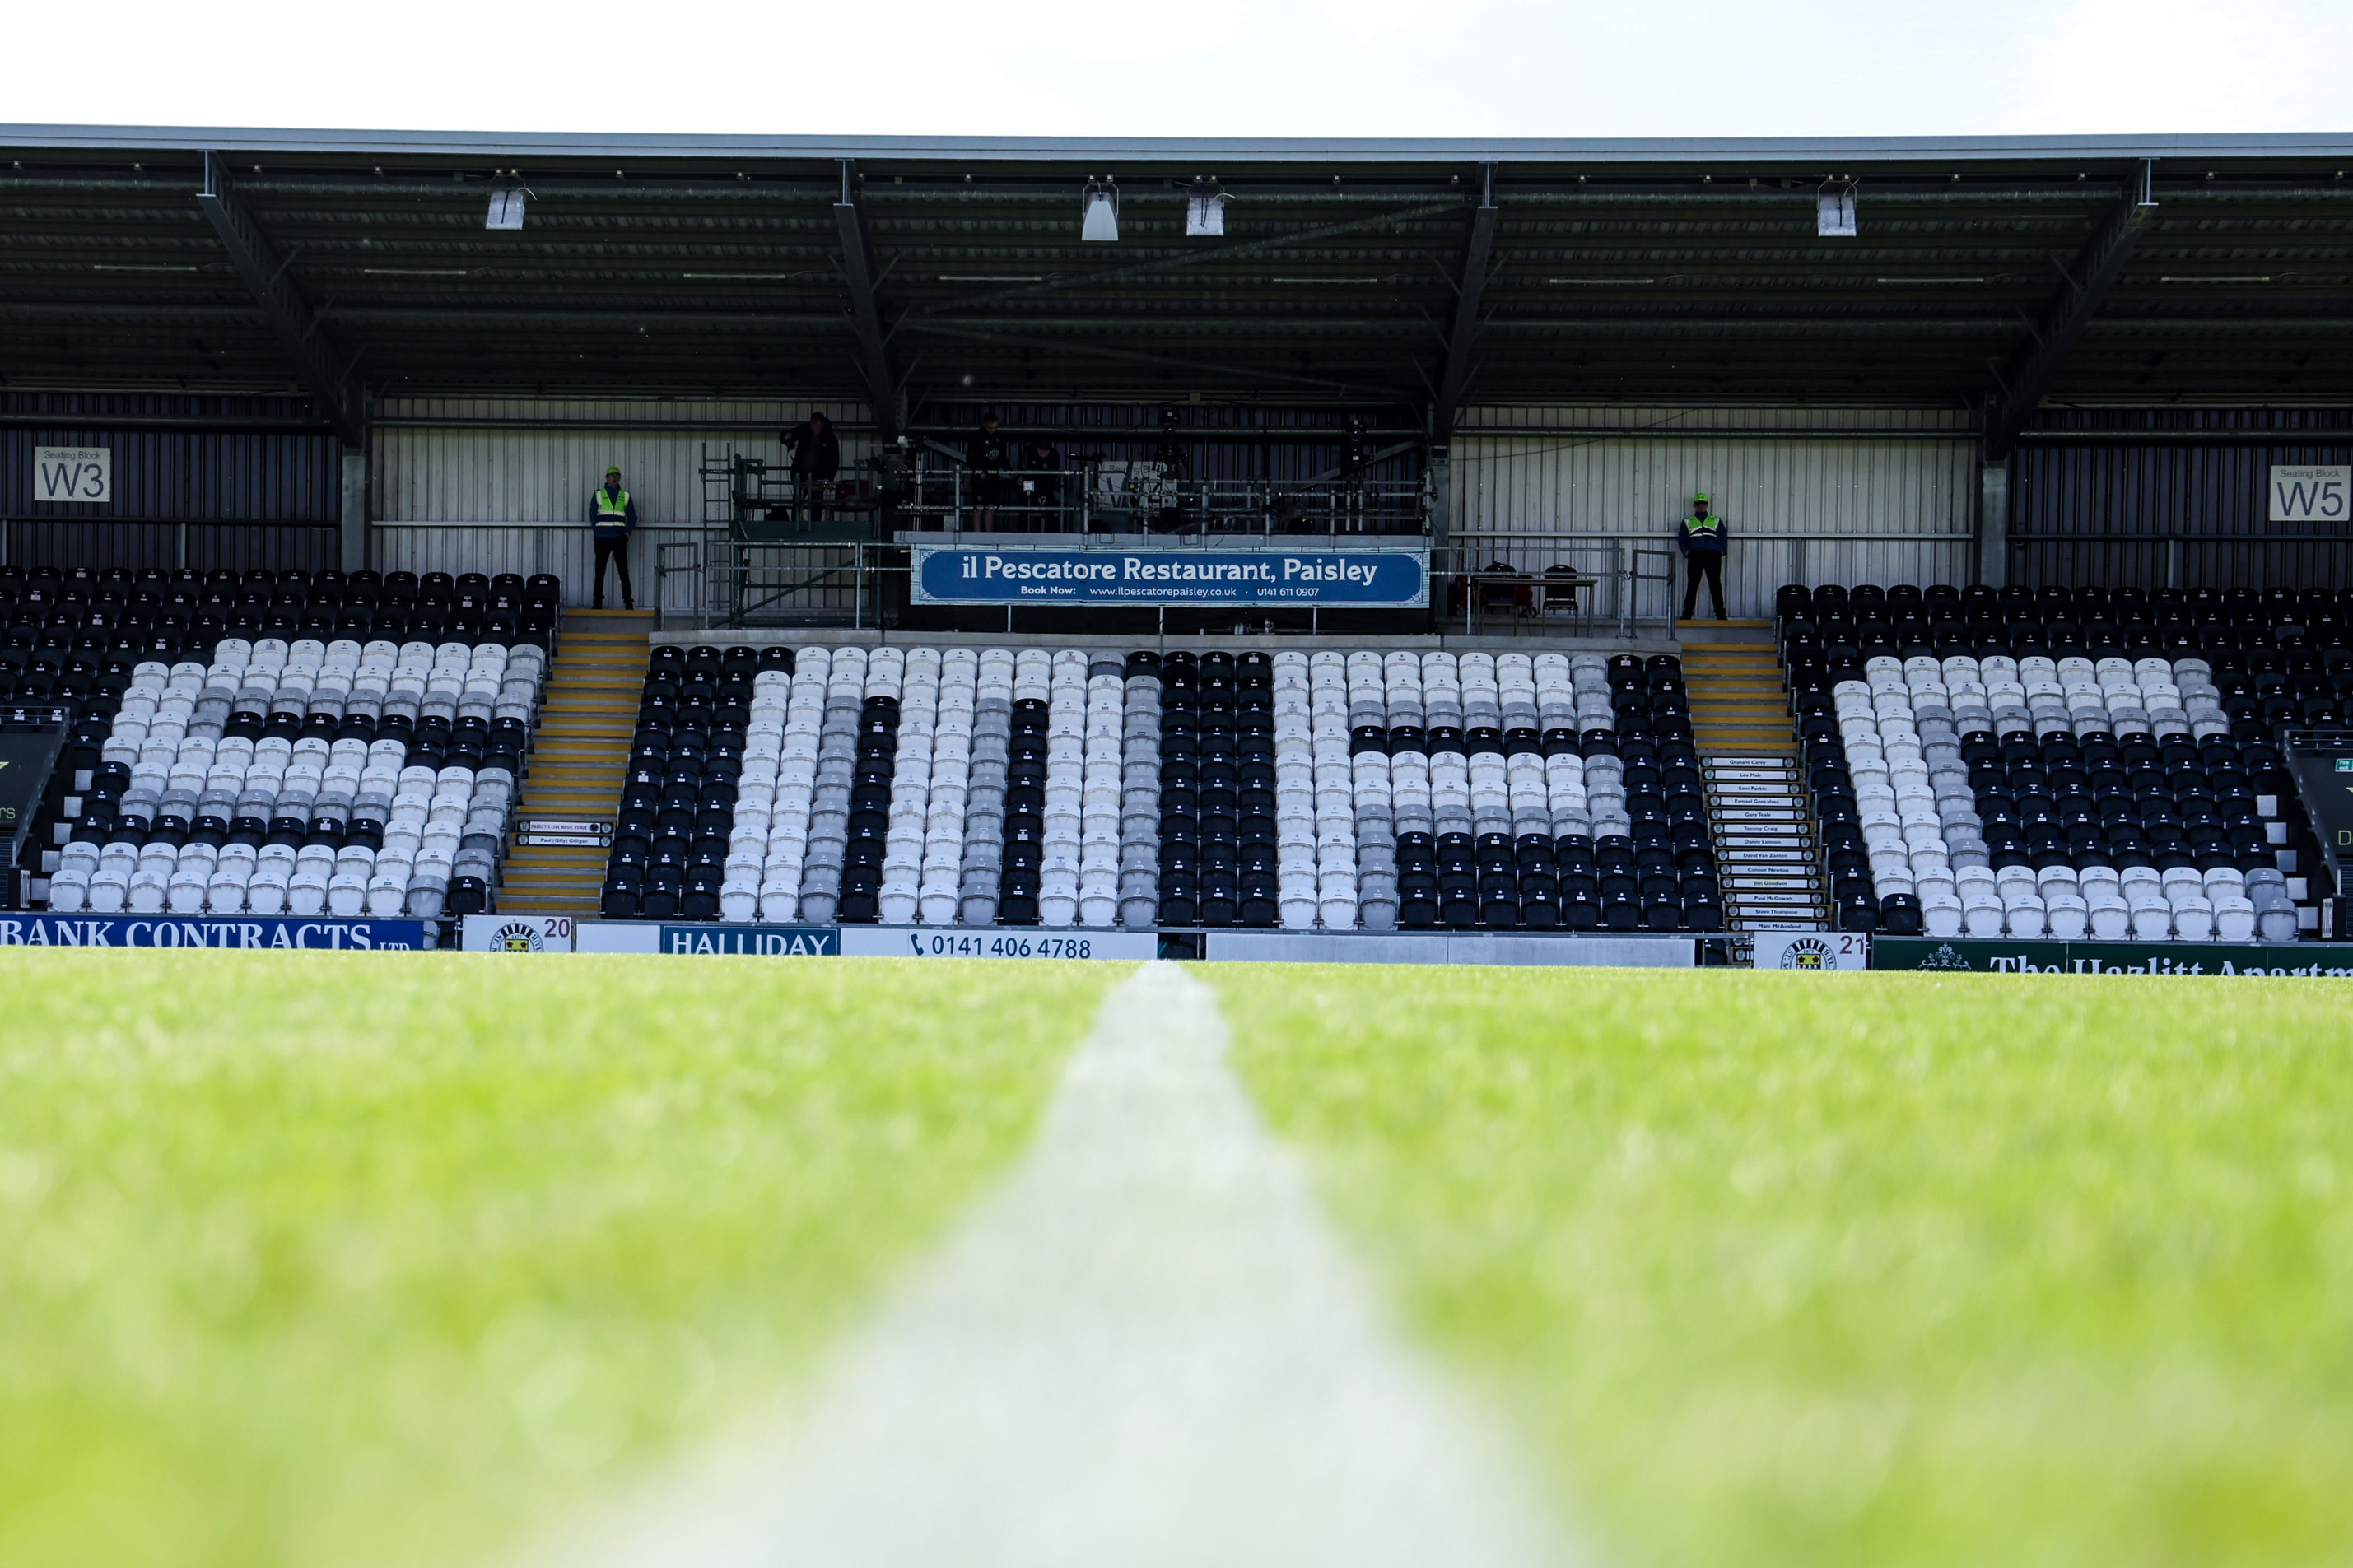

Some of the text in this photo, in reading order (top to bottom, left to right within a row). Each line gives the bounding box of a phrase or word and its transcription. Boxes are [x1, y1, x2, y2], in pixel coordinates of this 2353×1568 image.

[44, 451, 101, 461] Seating Block
[41, 463, 104, 498] W3
[2281, 469, 2340, 479] Seating Block
[2276, 482, 2343, 516] W5
[962, 556, 1378, 586] il Pescatore Restaurant, Paisley
[1020, 586, 1319, 597] Book Now: www.ilpescatorepaisley.co.uk 0141 611 0907
[0, 919, 114, 947] BANK
[126, 922, 370, 949] CONTRACTS
[544, 919, 571, 938] 20
[932, 935, 1091, 959] 0141 406 4788
[1839, 935, 1864, 955] 21
